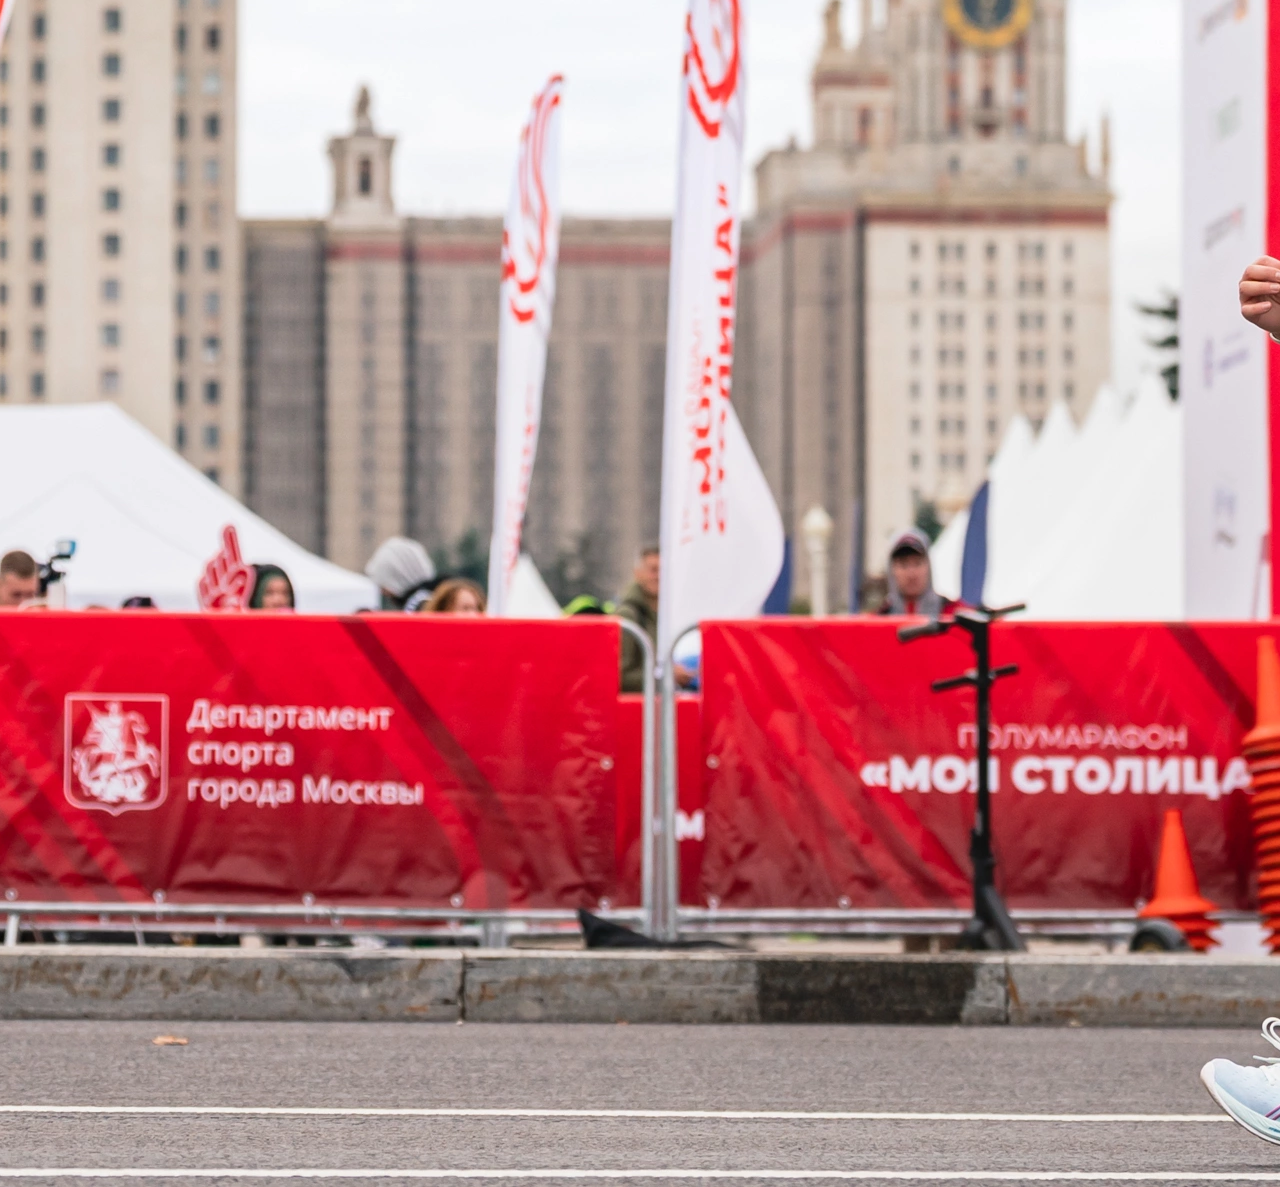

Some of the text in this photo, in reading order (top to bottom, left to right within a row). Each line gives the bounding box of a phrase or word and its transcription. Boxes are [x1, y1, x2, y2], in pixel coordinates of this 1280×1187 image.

[186, 698, 394, 737] Департамент
[957, 722, 1188, 750] ПОЛУМАРАФОН
[187, 741, 295, 773] спорта
[860, 755, 1000, 795] «МОЯ
[187, 773, 424, 809] города Москвы
